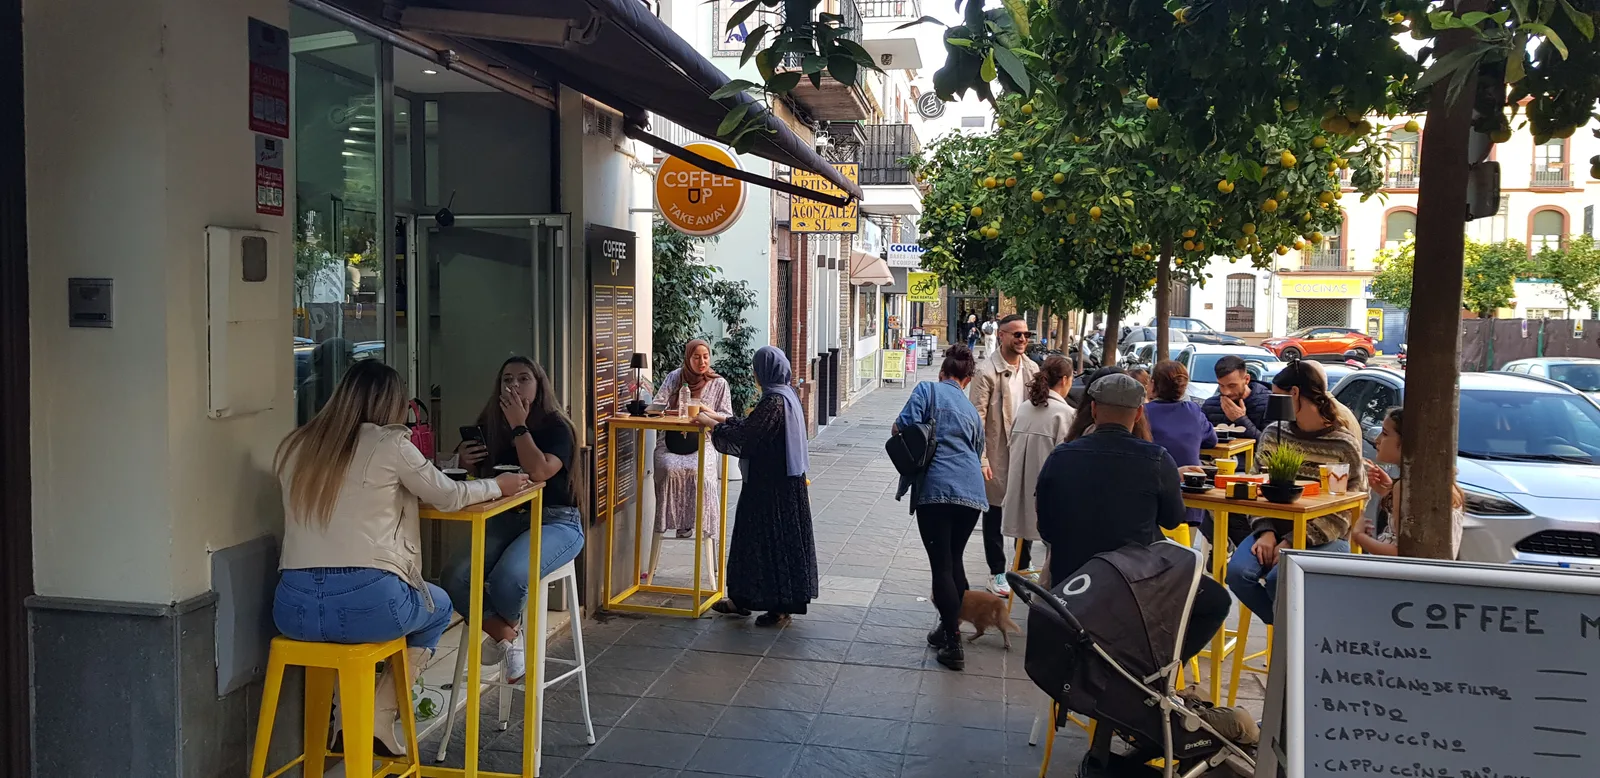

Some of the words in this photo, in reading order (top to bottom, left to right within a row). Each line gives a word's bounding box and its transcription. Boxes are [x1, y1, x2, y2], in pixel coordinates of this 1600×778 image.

[257, 168, 282, 182] Alarma
[663, 171, 734, 188] COFFEE
[688, 187, 713, 204] UP
[669, 203, 695, 225] TAKE
[696, 204, 727, 226] AWAY
[602, 239, 627, 259] COFFEE
[891, 245, 928, 253] COLCHO
[610, 259, 620, 276] UP
[1295, 284, 1348, 293] COCINAS
[1391, 601, 1545, 635] COFFEE
[1433, 681, 1453, 694] DE
[1457, 682, 1512, 701] FILTRO
